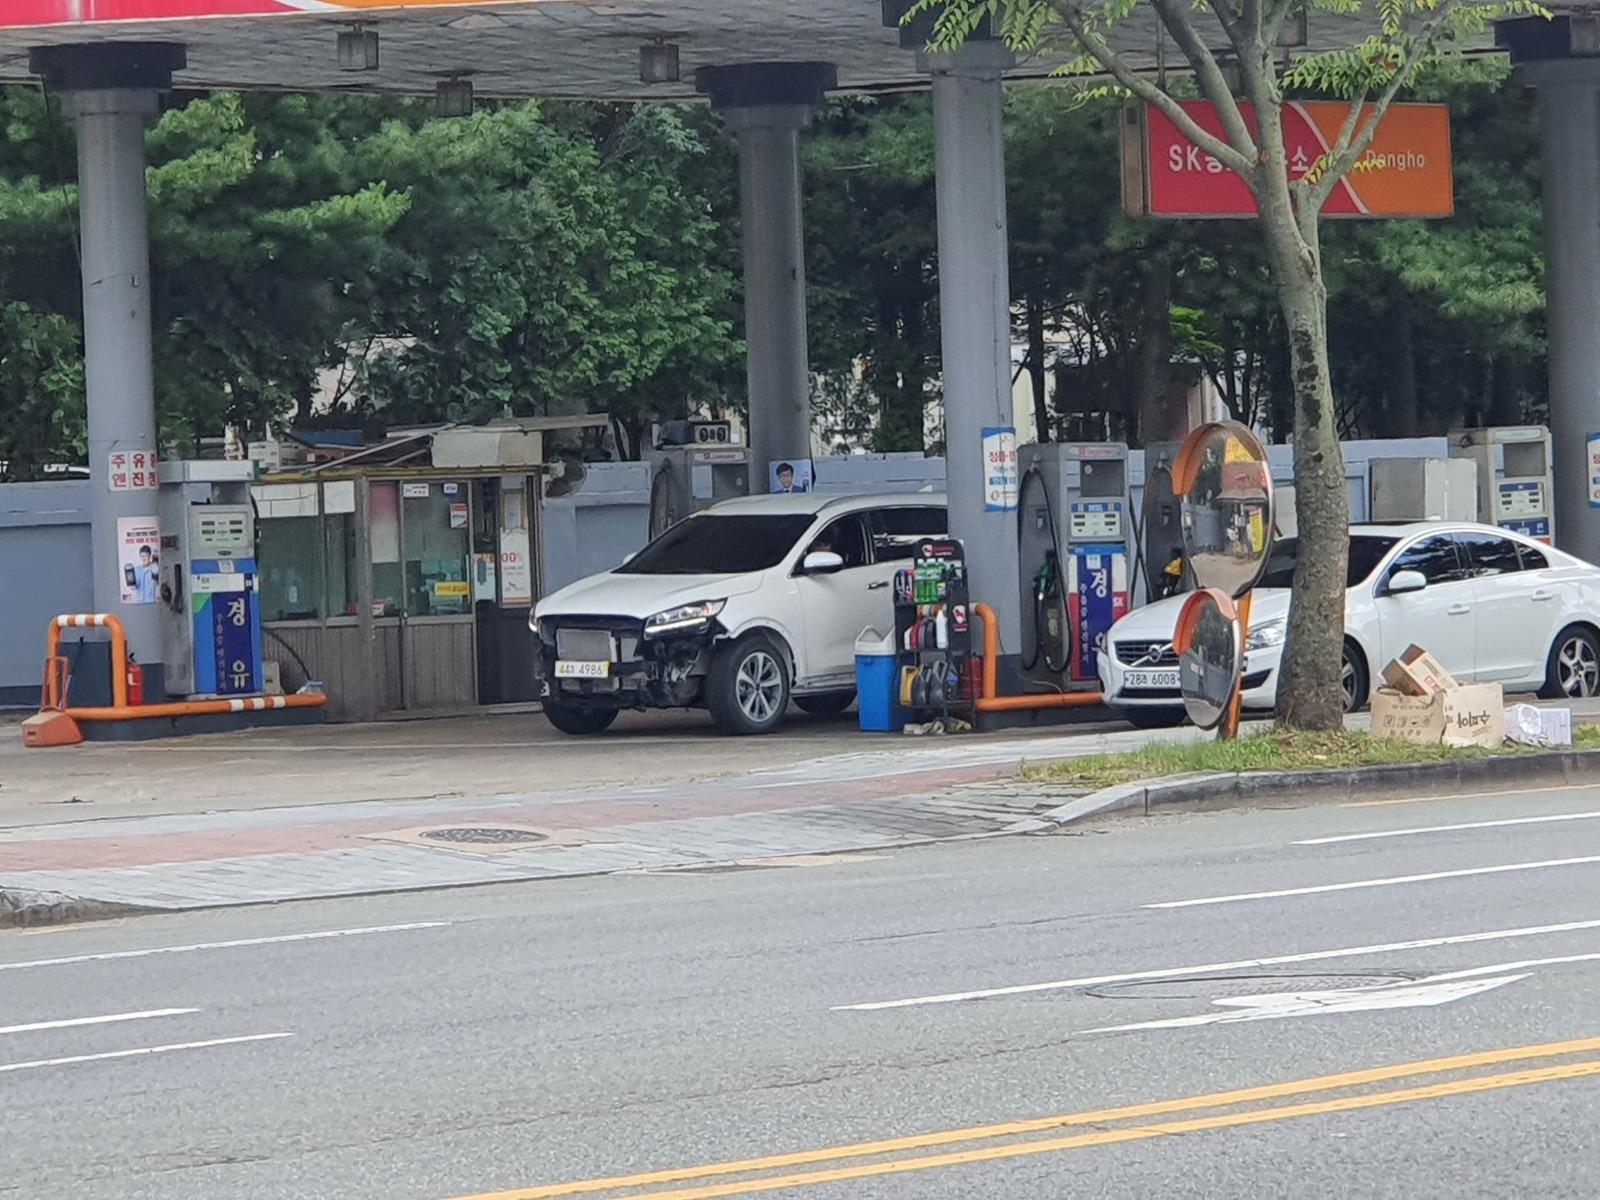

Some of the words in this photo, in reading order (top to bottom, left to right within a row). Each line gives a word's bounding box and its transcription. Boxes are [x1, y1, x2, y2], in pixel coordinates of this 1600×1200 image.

[226, 597, 251, 689] 경유
[578, 664, 604, 676] 4986
[1151, 673, 1177, 685] 6008
